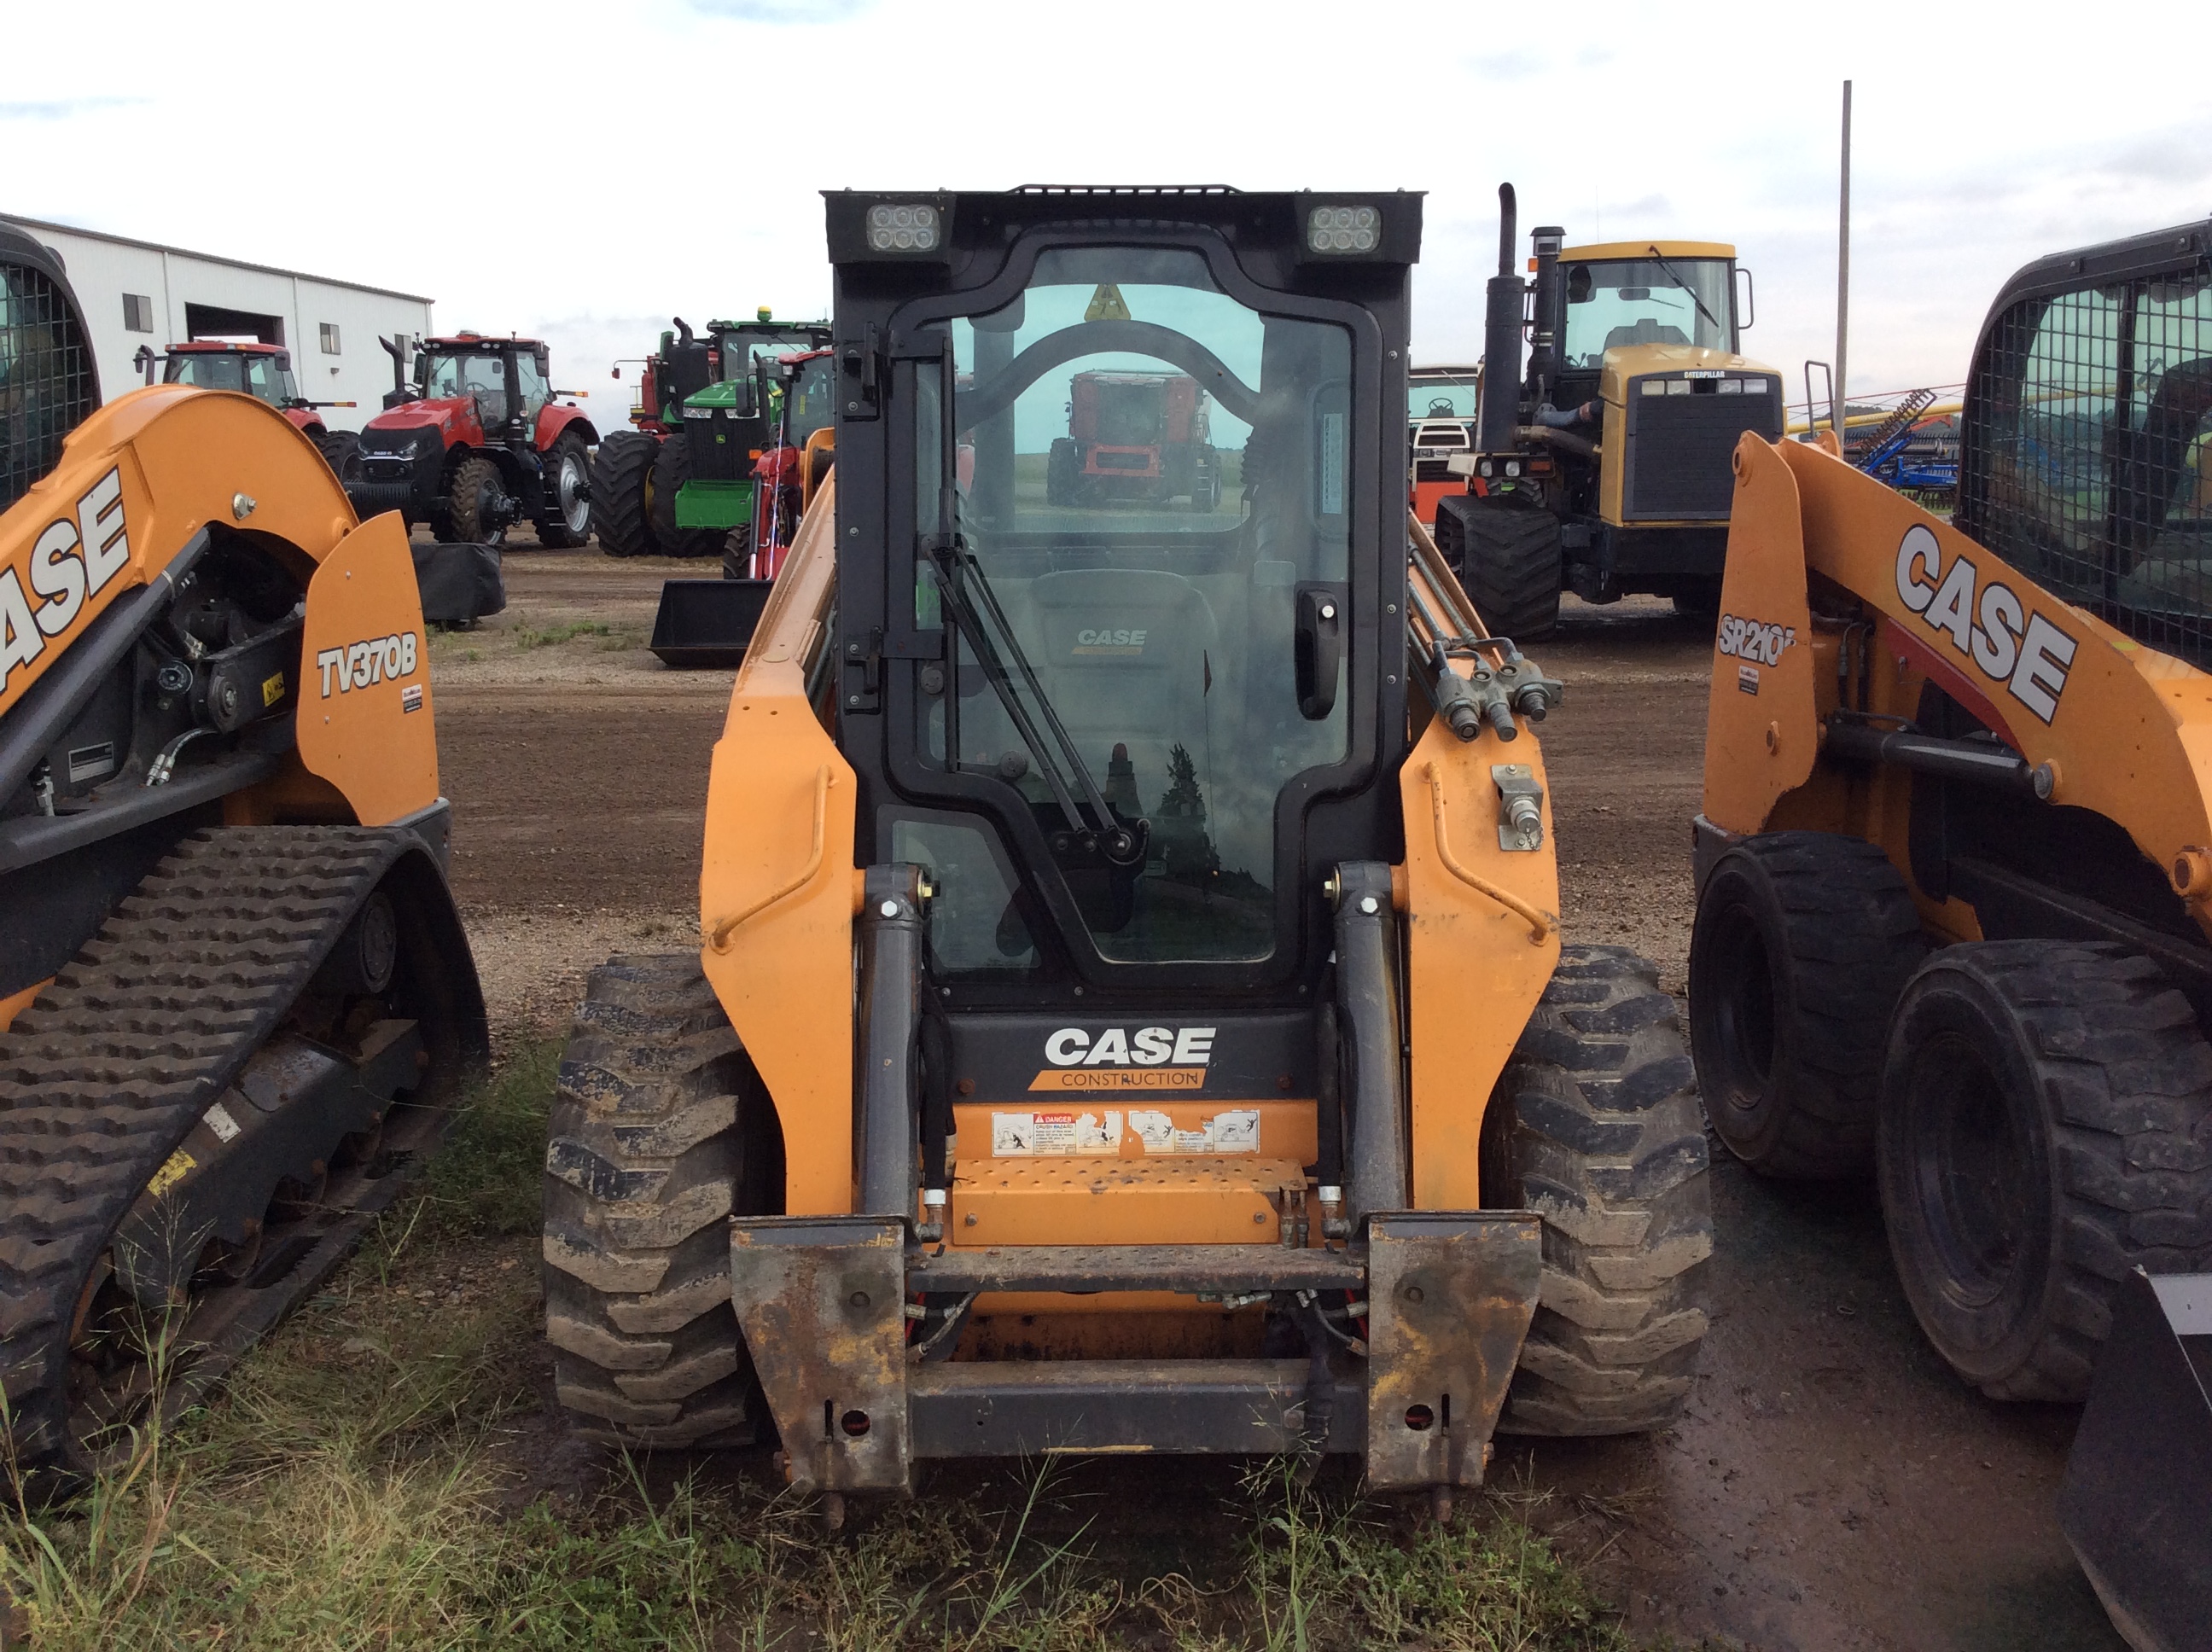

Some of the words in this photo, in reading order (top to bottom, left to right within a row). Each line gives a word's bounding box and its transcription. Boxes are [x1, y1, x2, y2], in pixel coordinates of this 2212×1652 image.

[1684, 370, 1726, 379] CATERPILLAR
[1078, 629, 1147, 645] CASE
[1895, 523, 2080, 727] CASE
[317, 631, 417, 700] TV370B
[1045, 1027, 1217, 1066] CASE
[1062, 1073, 1198, 1086] CONSTRUCTION
